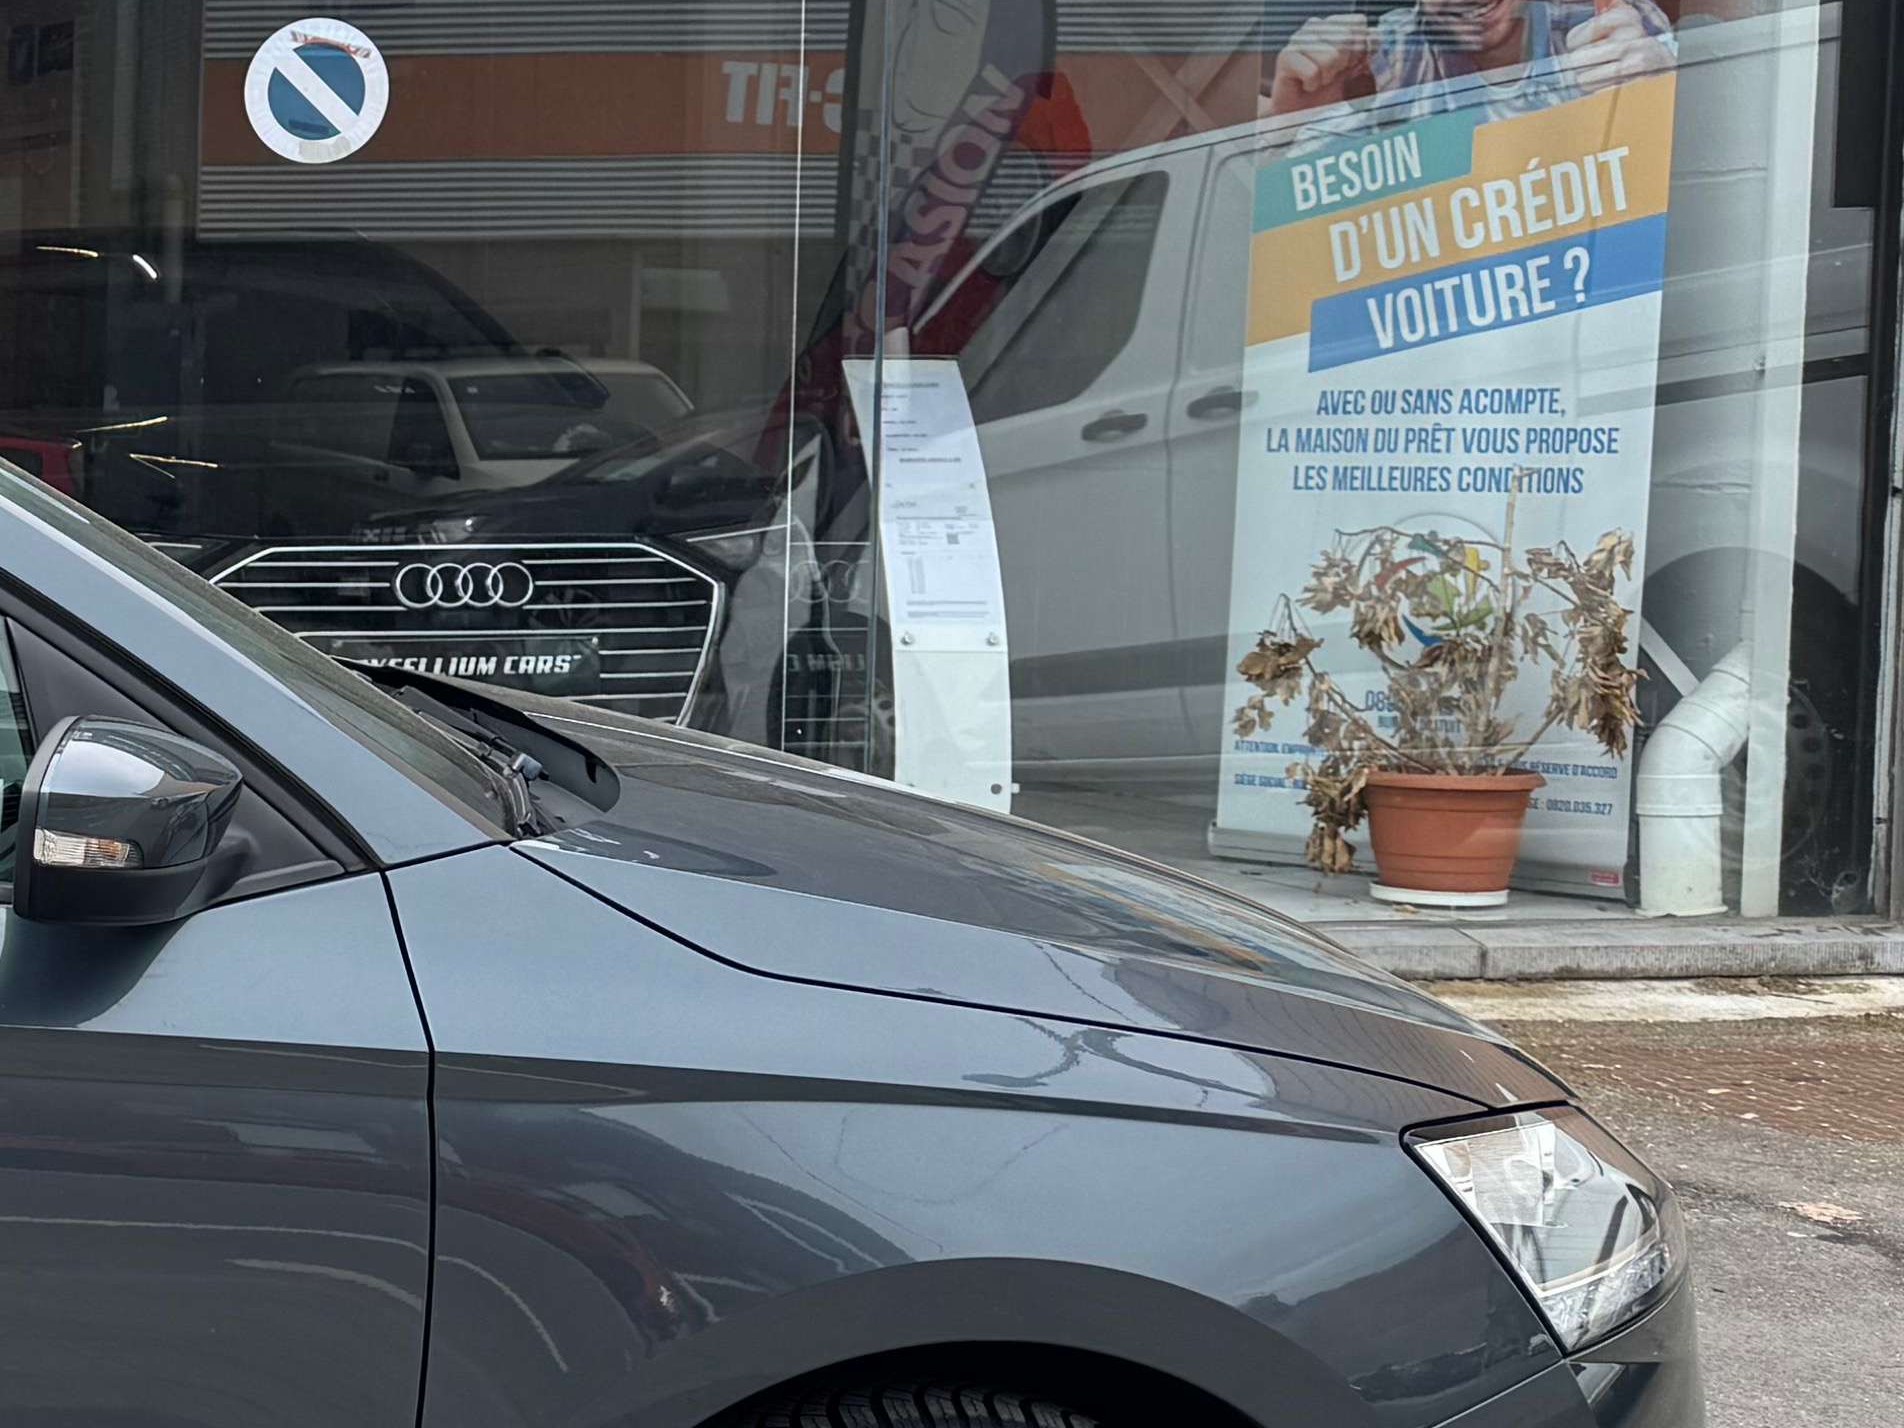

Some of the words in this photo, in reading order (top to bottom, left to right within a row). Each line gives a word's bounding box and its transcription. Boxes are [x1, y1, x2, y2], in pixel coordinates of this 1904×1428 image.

[1291, 131, 1422, 212] BESOIN
[1328, 197, 1441, 283] D'UN
[1449, 146, 1630, 250] CRÉDIT
[1367, 255, 1556, 349] VOITURE
[1563, 246, 1591, 303] ?
[1316, 390, 1365, 415] AVEC
[1370, 390, 1396, 415] OU
[1400, 388, 1452, 414] SANS
[1458, 388, 1566, 418] ACOMPTE,
[1266, 427, 1290, 453] LA
[1295, 427, 1368, 454] MAISON
[1373, 427, 1399, 454] DU
[1403, 423, 1456, 454] PRÊT
[1461, 427, 1520, 454] VOUS
[1525, 427, 1620, 455] PROPOSE
[1292, 465, 1328, 491] LES
[1331, 466, 1452, 492] MEILLEURES
[362, 655, 497, 677] XCELLIUM
[504, 654, 572, 676] CARS
